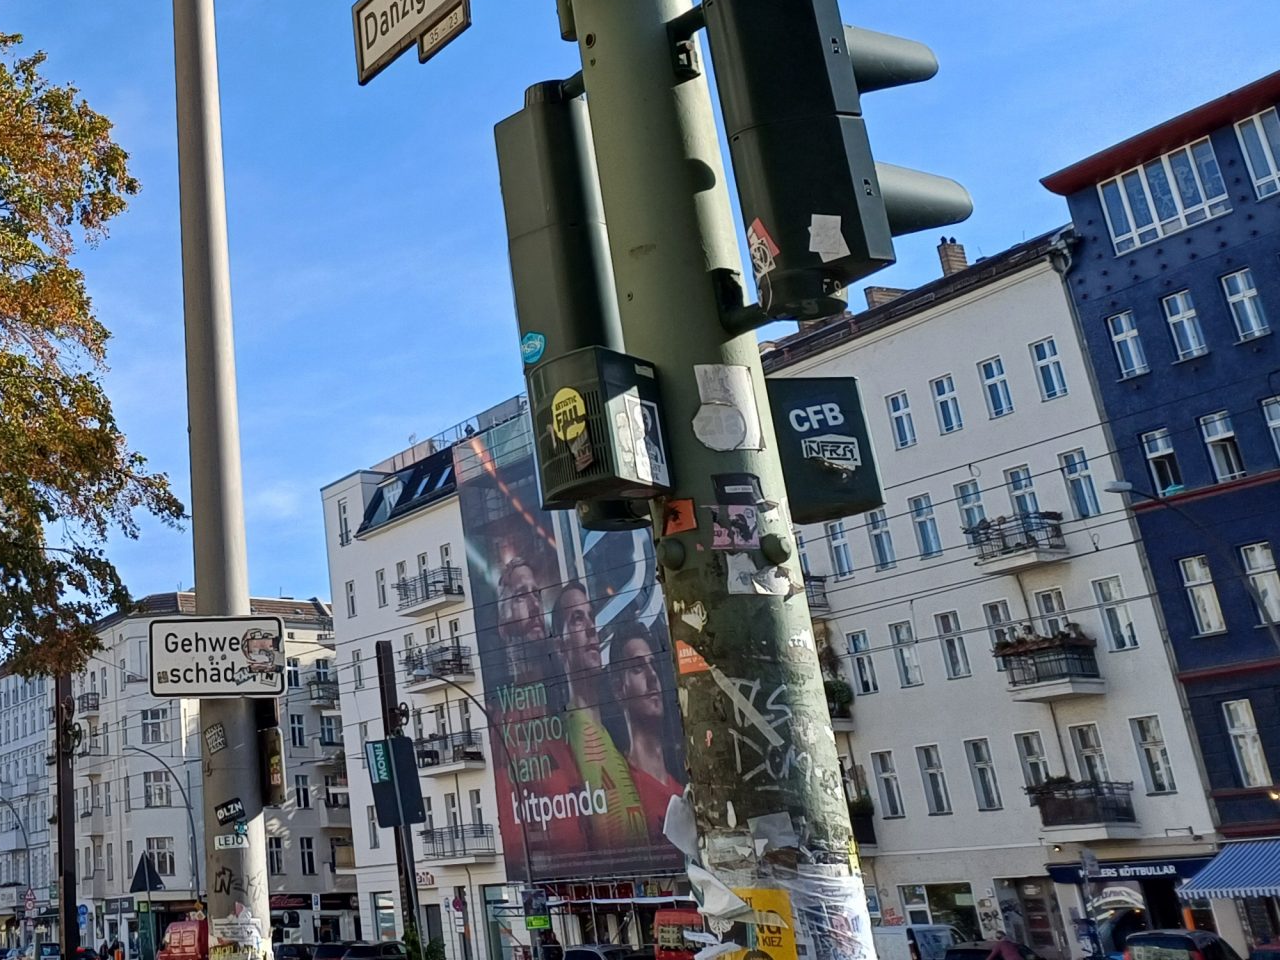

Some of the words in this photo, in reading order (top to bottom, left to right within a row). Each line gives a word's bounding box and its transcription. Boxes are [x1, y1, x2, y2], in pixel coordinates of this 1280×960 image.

[429, 29, 439, 45] 35
[449, 12, 459, 29] 23
[789, 402, 844, 432] CFB
[165, 632, 241, 653] Gehwe
[169, 661, 256, 683] schäd
[497, 682, 547, 714] Wenn
[502, 715, 569, 753] Krypto,
[511, 781, 608, 832] bitpanda
[762, 936, 783, 947] KIEZ
